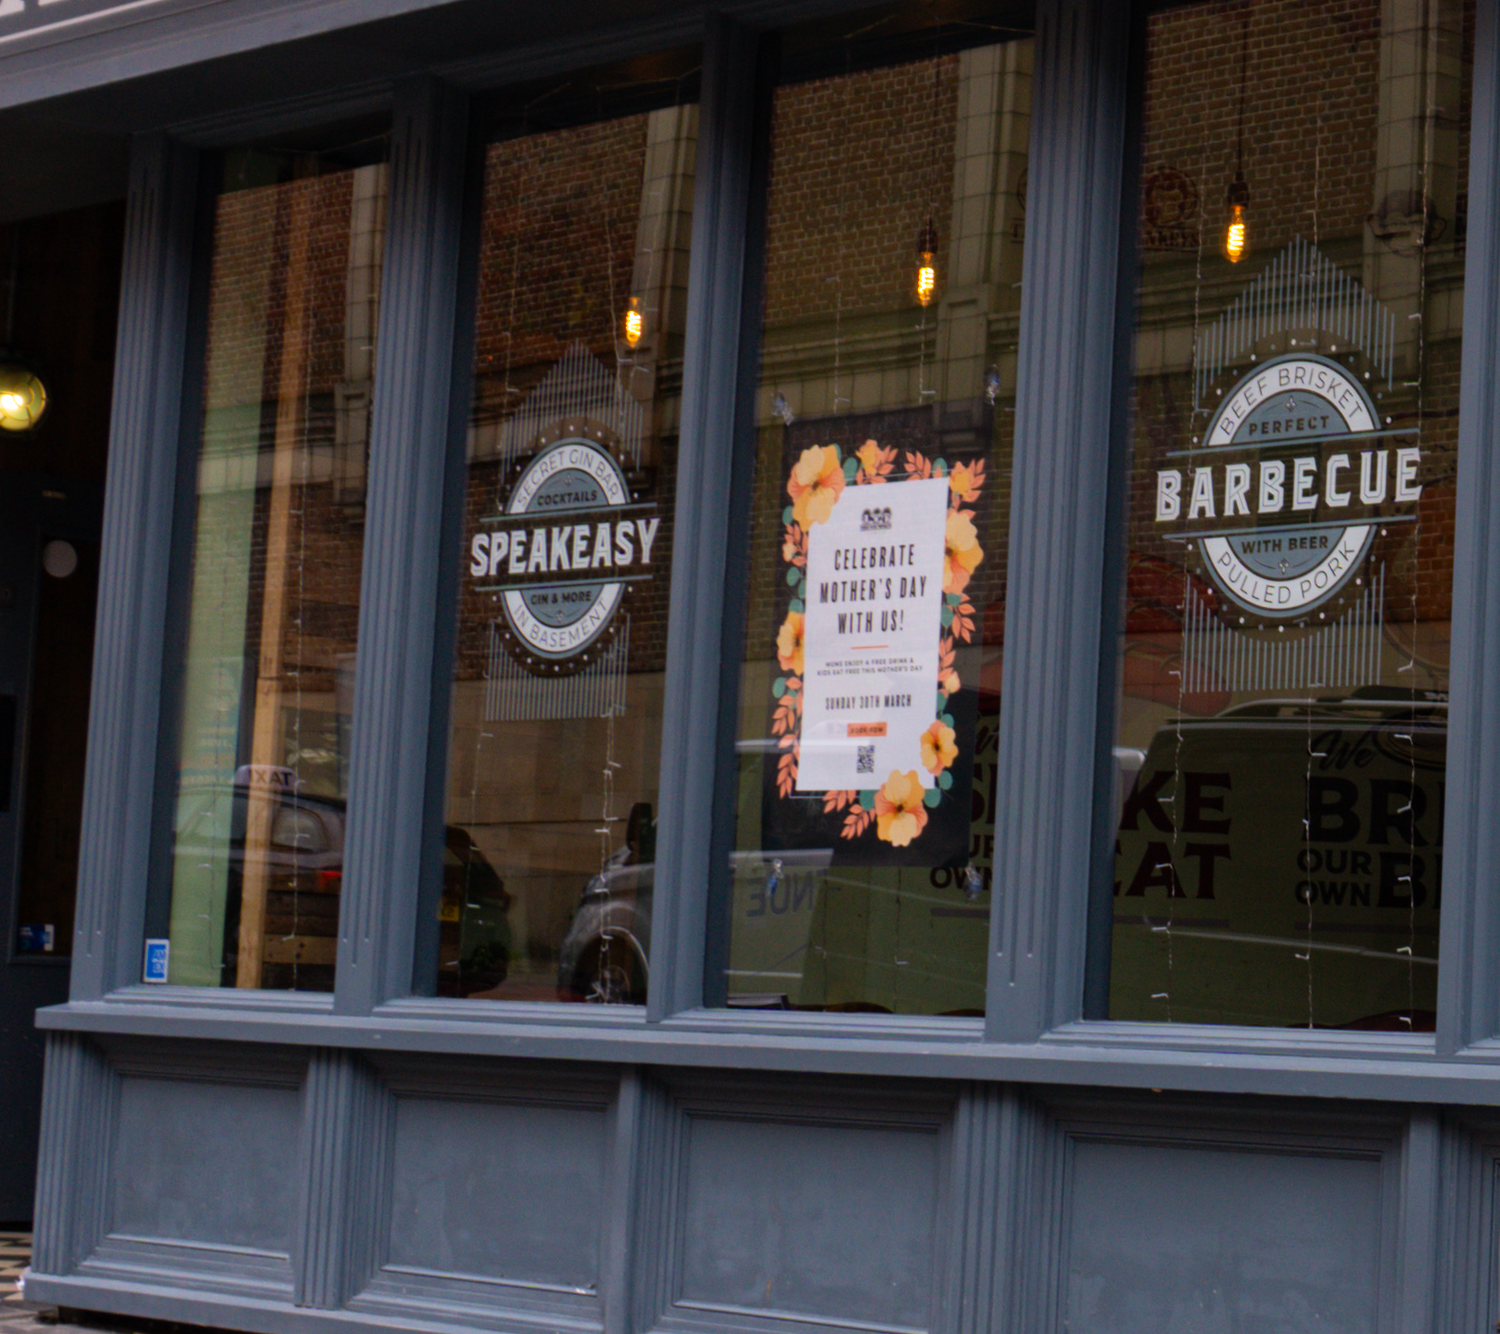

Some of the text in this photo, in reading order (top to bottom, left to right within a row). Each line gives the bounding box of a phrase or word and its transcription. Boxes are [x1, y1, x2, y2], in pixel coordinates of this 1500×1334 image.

[1219, 366, 1364, 436] BEEF BRISKET
[1248, 414, 1330, 436] PERFECT
[516, 448, 621, 508] SECRET GIN BAR
[1155, 447, 1424, 523] BARBECUE
[536, 489, 598, 507] COCKTAILS
[469, 517, 661, 578] SPEAKEASY
[834, 543, 916, 572] CELEBRATE
[1240, 534, 1330, 555] WITH BEER
[1217, 539, 1356, 605] PULLED PORK
[530, 590, 593, 606] GIN & MORE
[819, 574, 928, 604] MOTHER'S DAY
[513, 597, 609, 649] IN BASEMENT
[837, 608, 905, 635] WITH US!
[824, 692, 913, 712] SUNDAY 30TH MARCH
[1307, 729, 1378, 772] We
[1296, 847, 1373, 876] OUR
[1294, 879, 1372, 908] OWN
